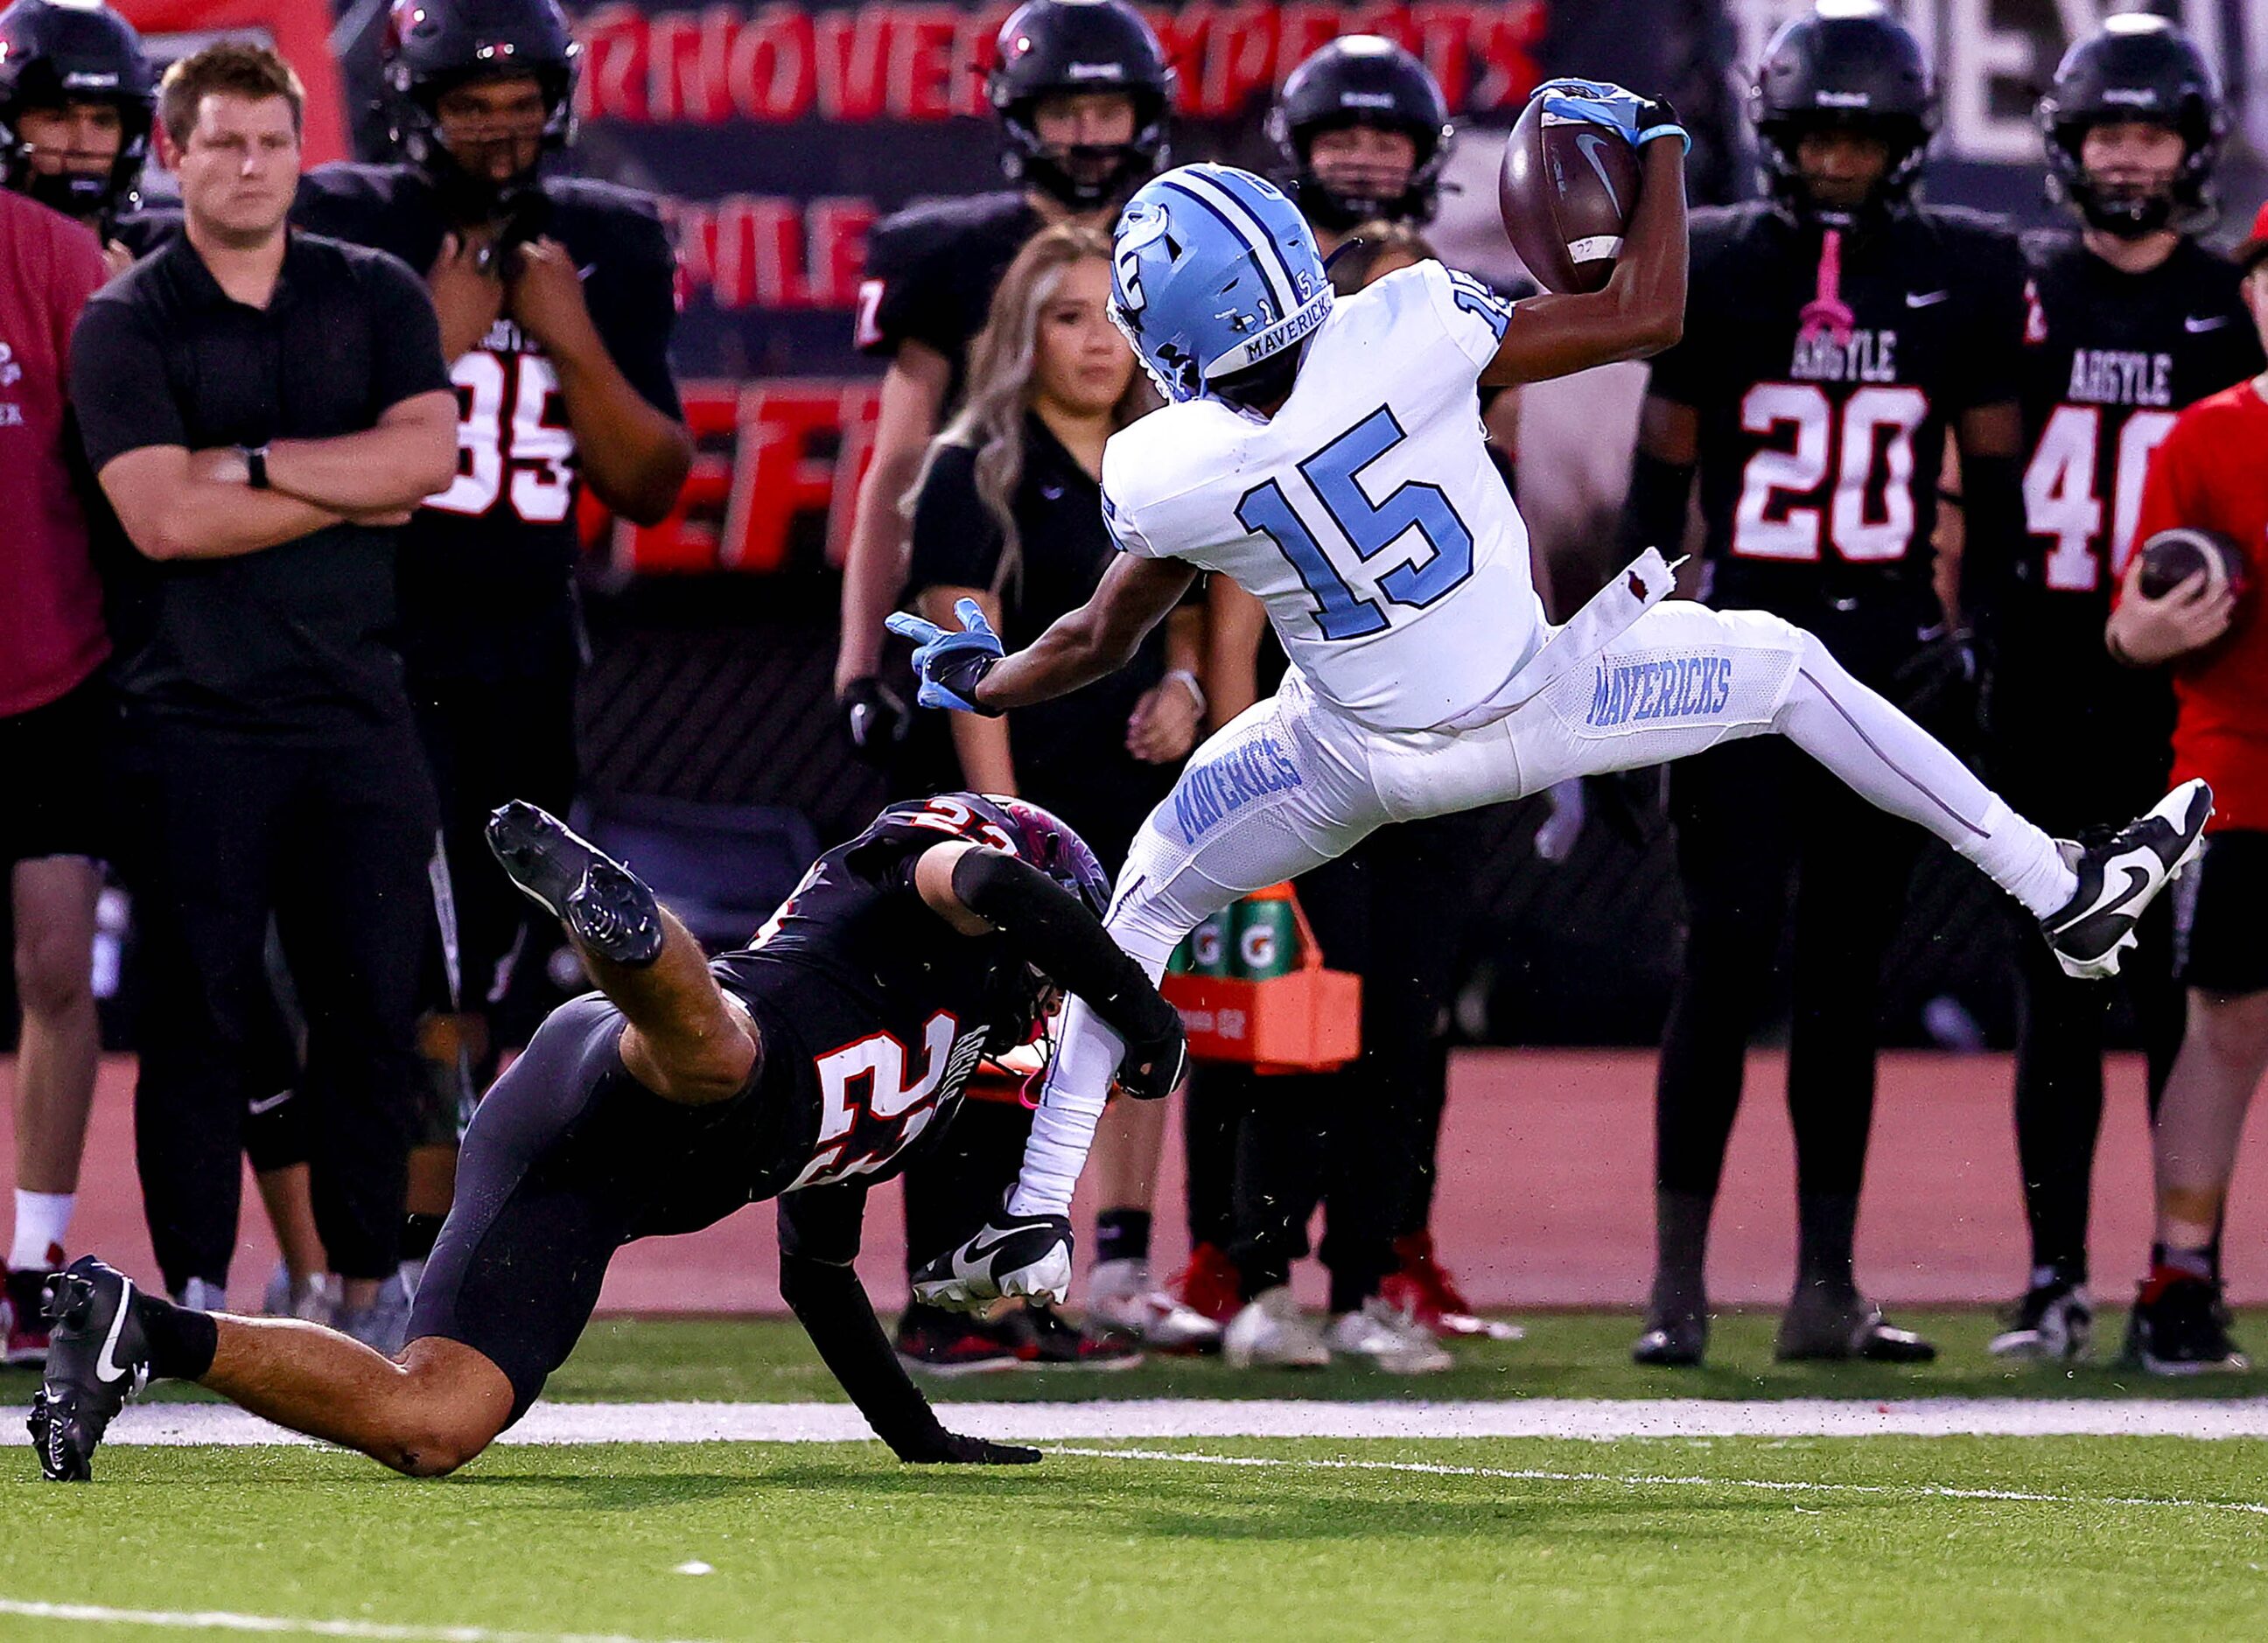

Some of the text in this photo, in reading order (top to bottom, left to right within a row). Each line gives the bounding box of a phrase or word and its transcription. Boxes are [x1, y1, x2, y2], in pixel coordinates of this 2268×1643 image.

[1233, 402, 1474, 641] 15
[1732, 381, 1929, 563] 20
[1586, 657, 1732, 726] MAVERICKS
